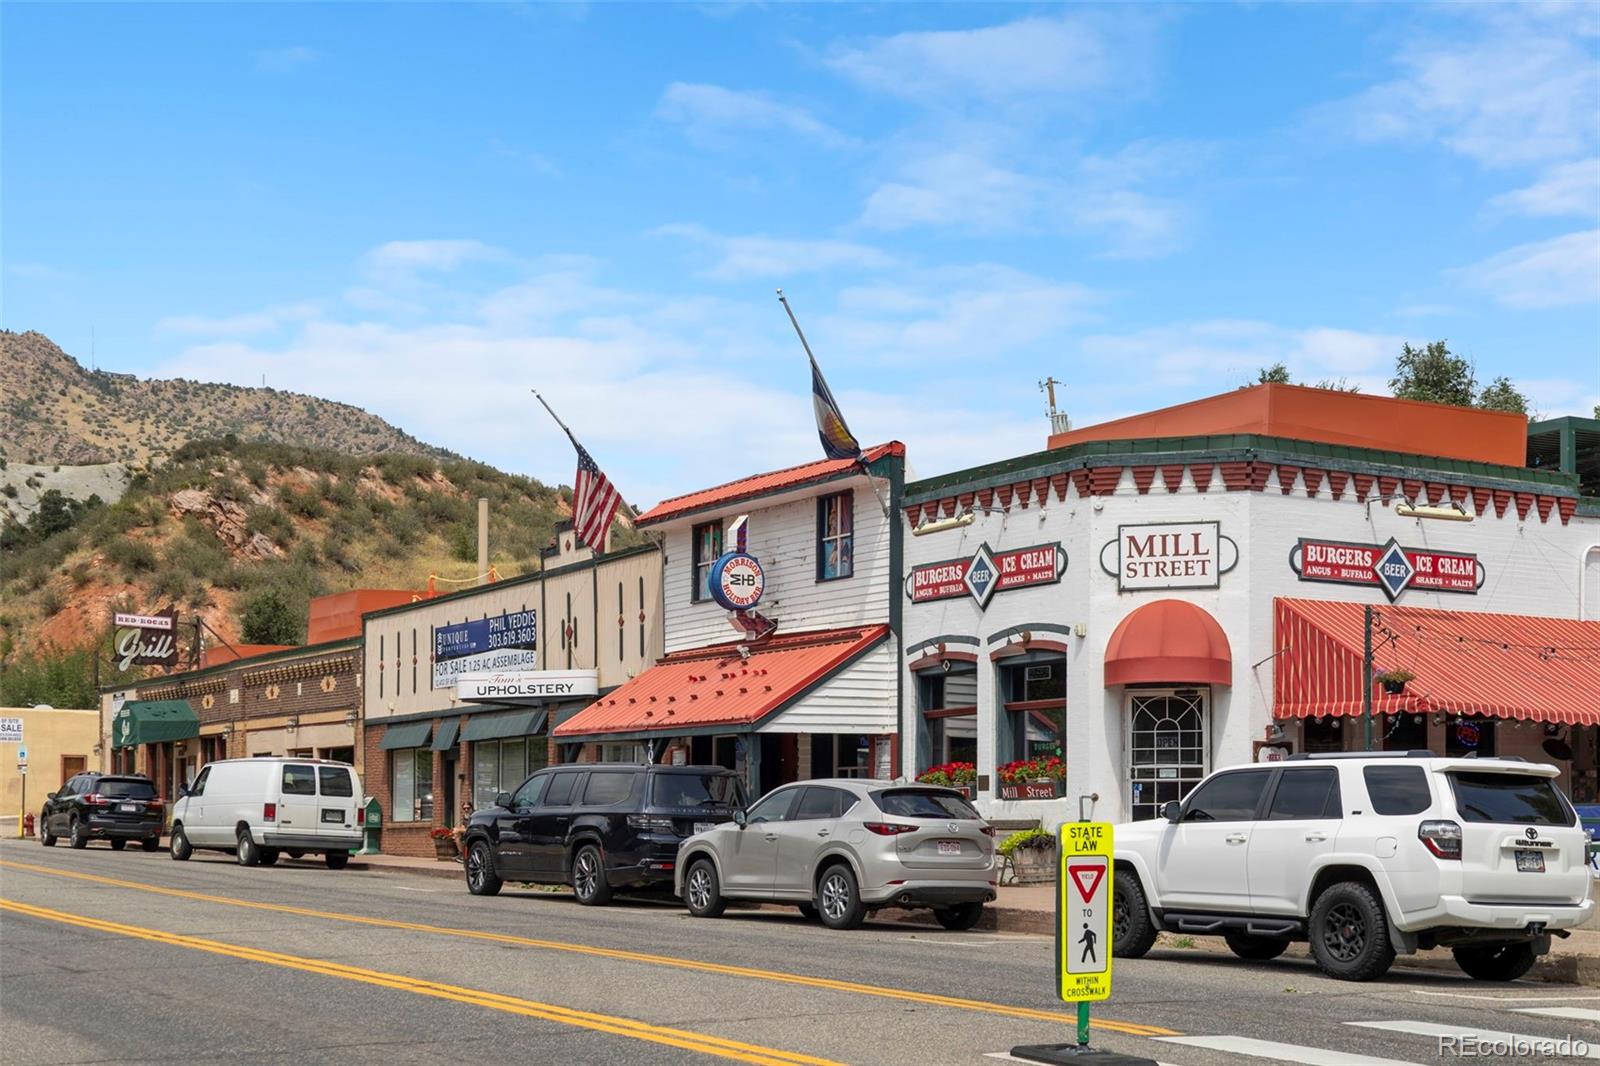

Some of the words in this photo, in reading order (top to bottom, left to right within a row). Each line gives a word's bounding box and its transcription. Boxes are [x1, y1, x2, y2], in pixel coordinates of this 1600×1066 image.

[1126, 533, 1210, 559] MILL
[1002, 556, 1017, 573] ICE
[1020, 549, 1053, 570] CREAM
[1306, 545, 1373, 567] BURGERS
[724, 558, 762, 577] MORRISON
[1126, 559, 1211, 579] STREET
[1306, 566, 1331, 576] ANGUS
[1341, 569, 1373, 580] BUFFALO
[1384, 562, 1406, 578] BEER
[1415, 555, 1433, 573] ICE
[1437, 557, 1474, 576] CREAM
[915, 565, 963, 586] BURGERS
[972, 569, 990, 584] BEER
[1002, 576, 1025, 585] SHAKES
[1032, 570, 1053, 580] MALTS
[1415, 577, 1443, 585] SHAKES
[1451, 579, 1473, 588] MALTS
[723, 583, 749, 605] HOLIDAY
[750, 586, 762, 601] BAR
[915, 589, 933, 598] ANGUS
[939, 584, 963, 594] BUFFALO
[118, 616, 137, 624] RED
[140, 618, 169, 626] ROCKS
[489, 617, 506, 633] PHIL
[507, 611, 536, 629] YEDDIS
[442, 630, 469, 646] UNIQUE
[488, 627, 536, 648] 303.619.3603
[119, 628, 174, 671] Grill
[435, 662, 449, 677] FOR
[450, 659, 467, 675] SALE
[469, 659, 481, 671] 1.25
[482, 658, 491, 670] AC
[492, 651, 534, 668] ASSEMBLAGE
[488, 673, 522, 684] Tom's
[477, 683, 574, 696] UPHOLSTERY
[1, 724, 22, 732] SALE
[1002, 786, 1018, 799] Mill
[1026, 785, 1053, 798] Street
[1070, 826, 1103, 839] STATE
[1075, 840, 1098, 852] LAW
[1082, 908, 1093, 918] TO
[1075, 975, 1099, 986] WITHIN
[1066, 986, 1106, 997] CROSSWALK
